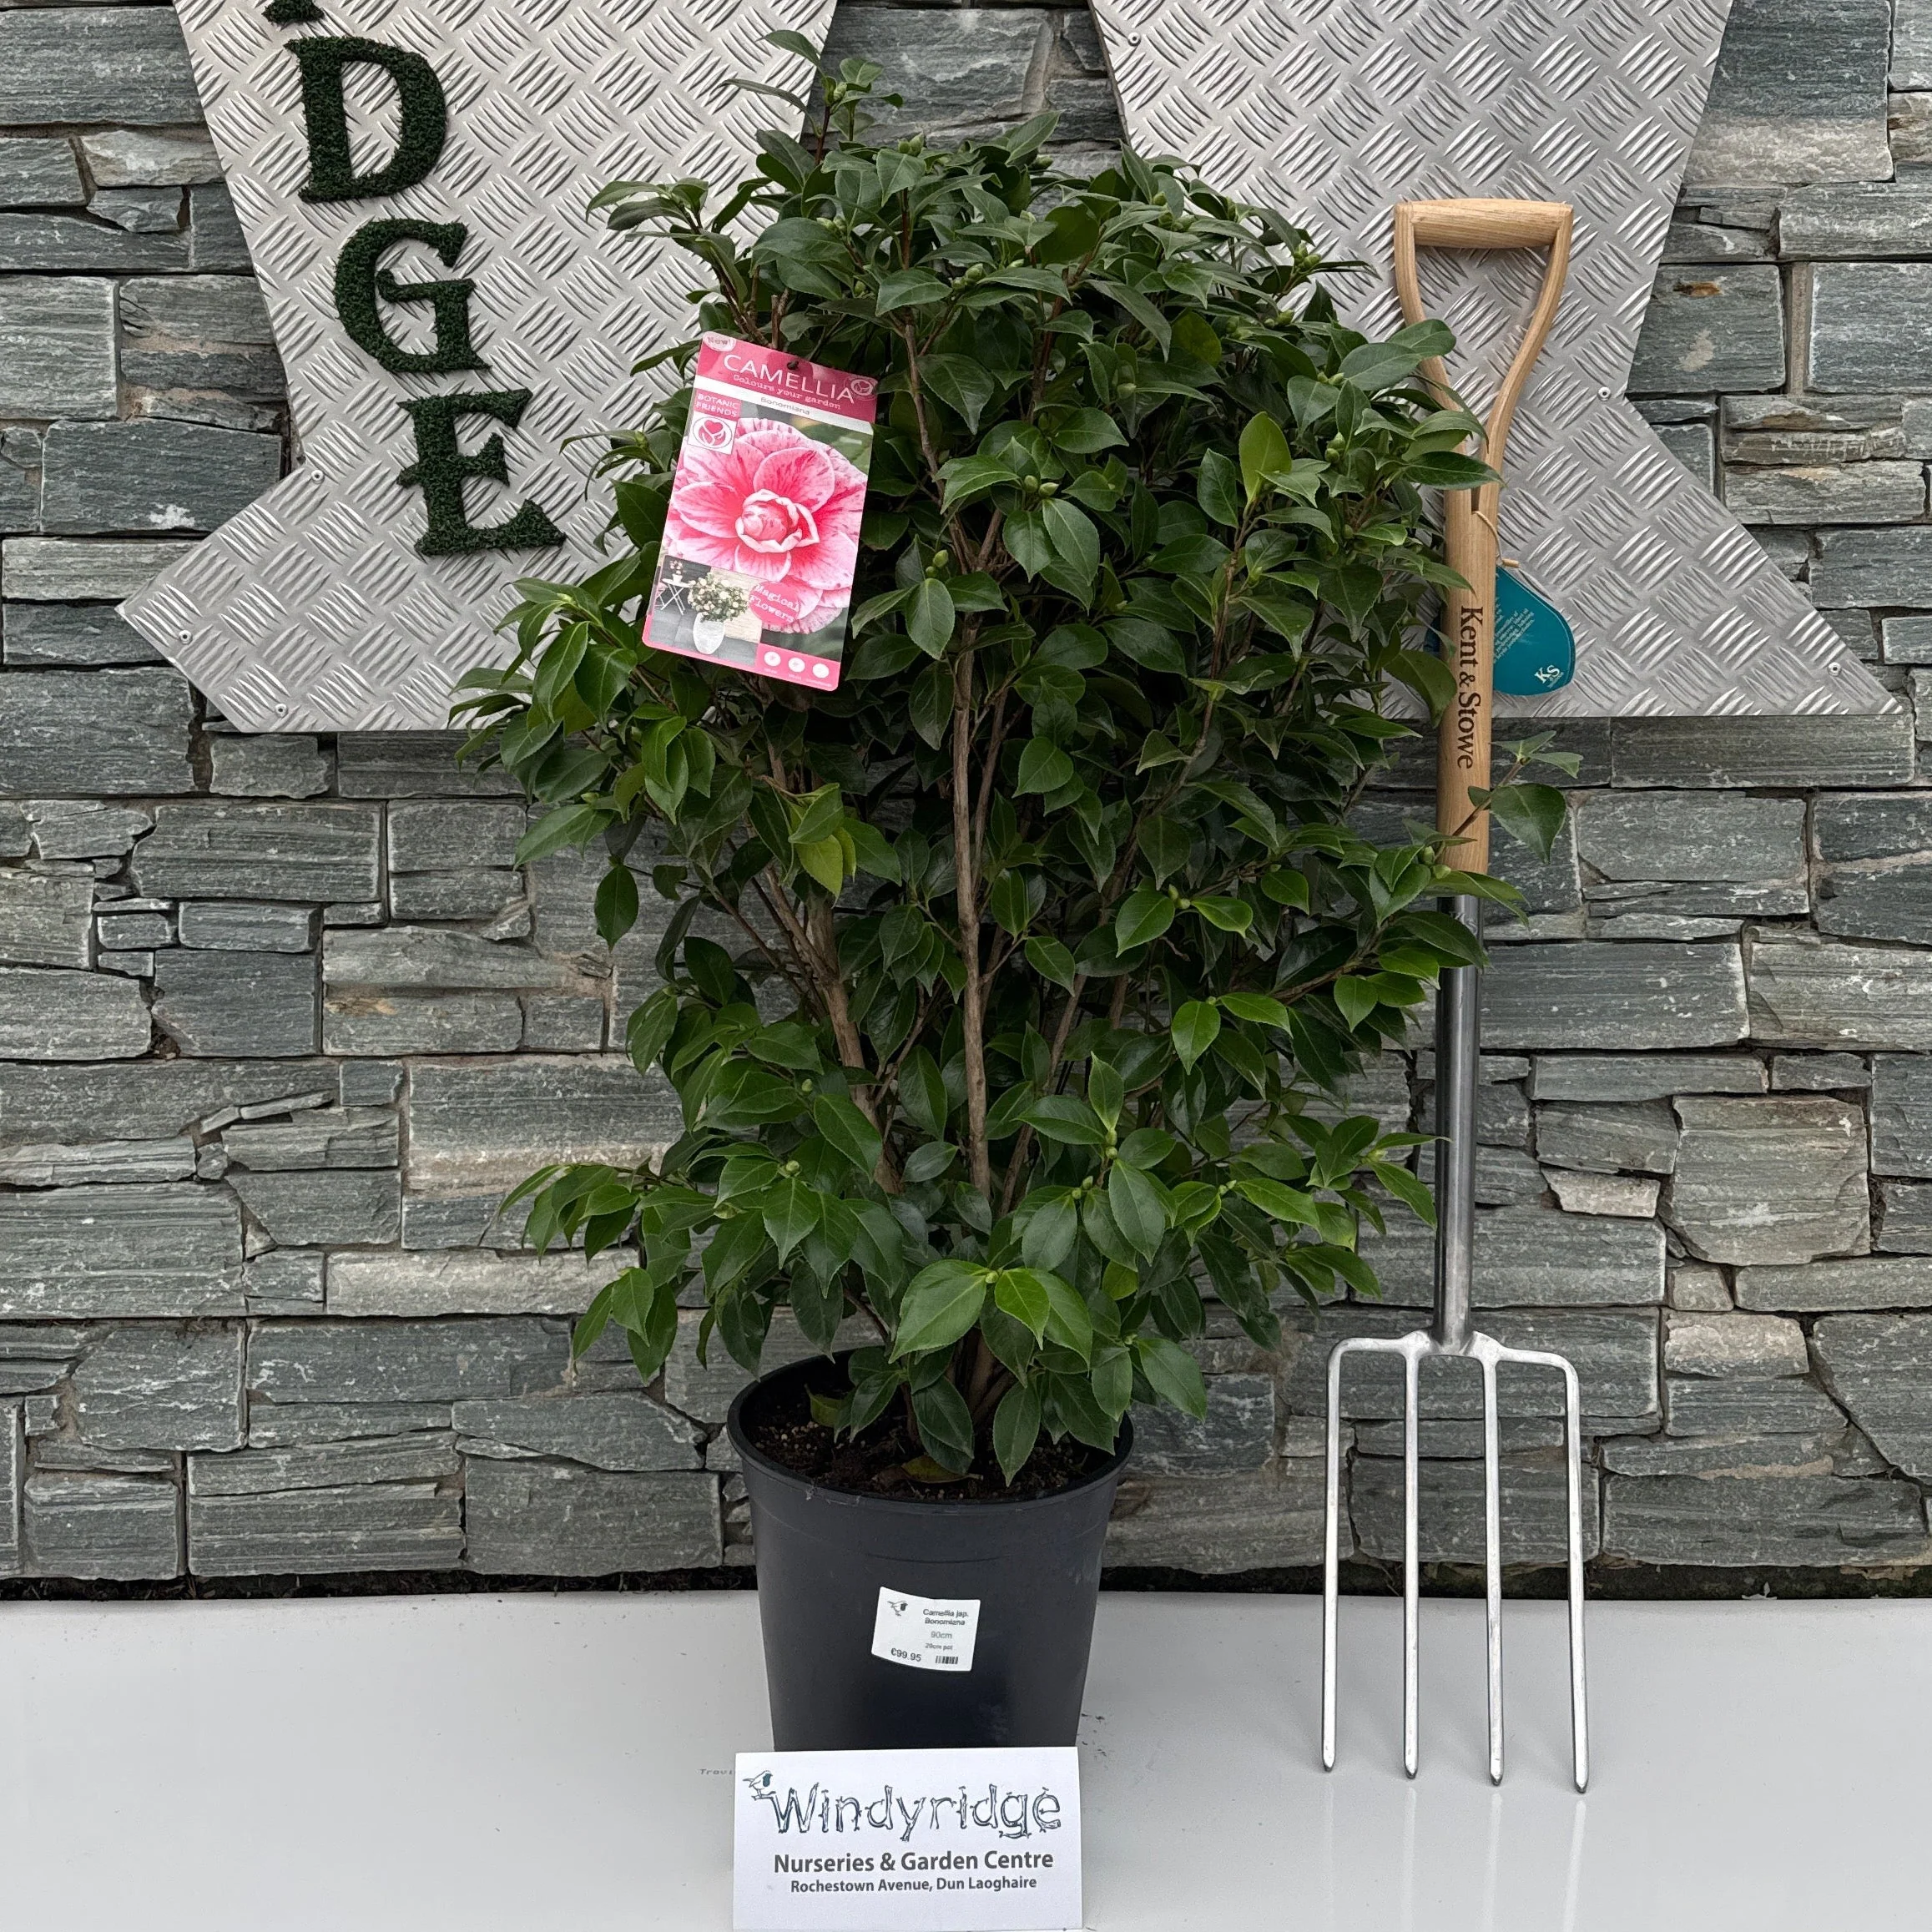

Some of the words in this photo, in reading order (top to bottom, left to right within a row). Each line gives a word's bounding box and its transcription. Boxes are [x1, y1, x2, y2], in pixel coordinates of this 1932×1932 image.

[261, 0, 567, 556] DGE
[724, 354, 855, 404] CAMELLIA
[733, 375, 775, 392] Colours
[777, 387, 802, 400] your
[805, 396, 841, 410] garden
[696, 403, 738, 417] FRIENDS
[697, 393, 739, 409] BOTANIC
[750, 595, 794, 623] Flowers
[754, 584, 800, 612] Magical
[1459, 606, 1483, 668] Kent
[1459, 672, 1475, 686] &
[1457, 692, 1481, 769] Stowe
[923, 1608, 954, 1617] Camellia
[890, 1647, 921, 1662] €99.95
[753, 1783, 1062, 1842] Windyridge
[774, 1853, 875, 1873] Nurseries
[880, 1852, 895, 1871] &
[901, 1850, 978, 1871] Garden
[984, 1850, 1054, 1869] Centre
[791, 1879, 874, 1893] Rochestown
[878, 1878, 933, 1892] Avenue,
[936, 1877, 964, 1890] Dun
[969, 1875, 1037, 1892] Laoghaire
